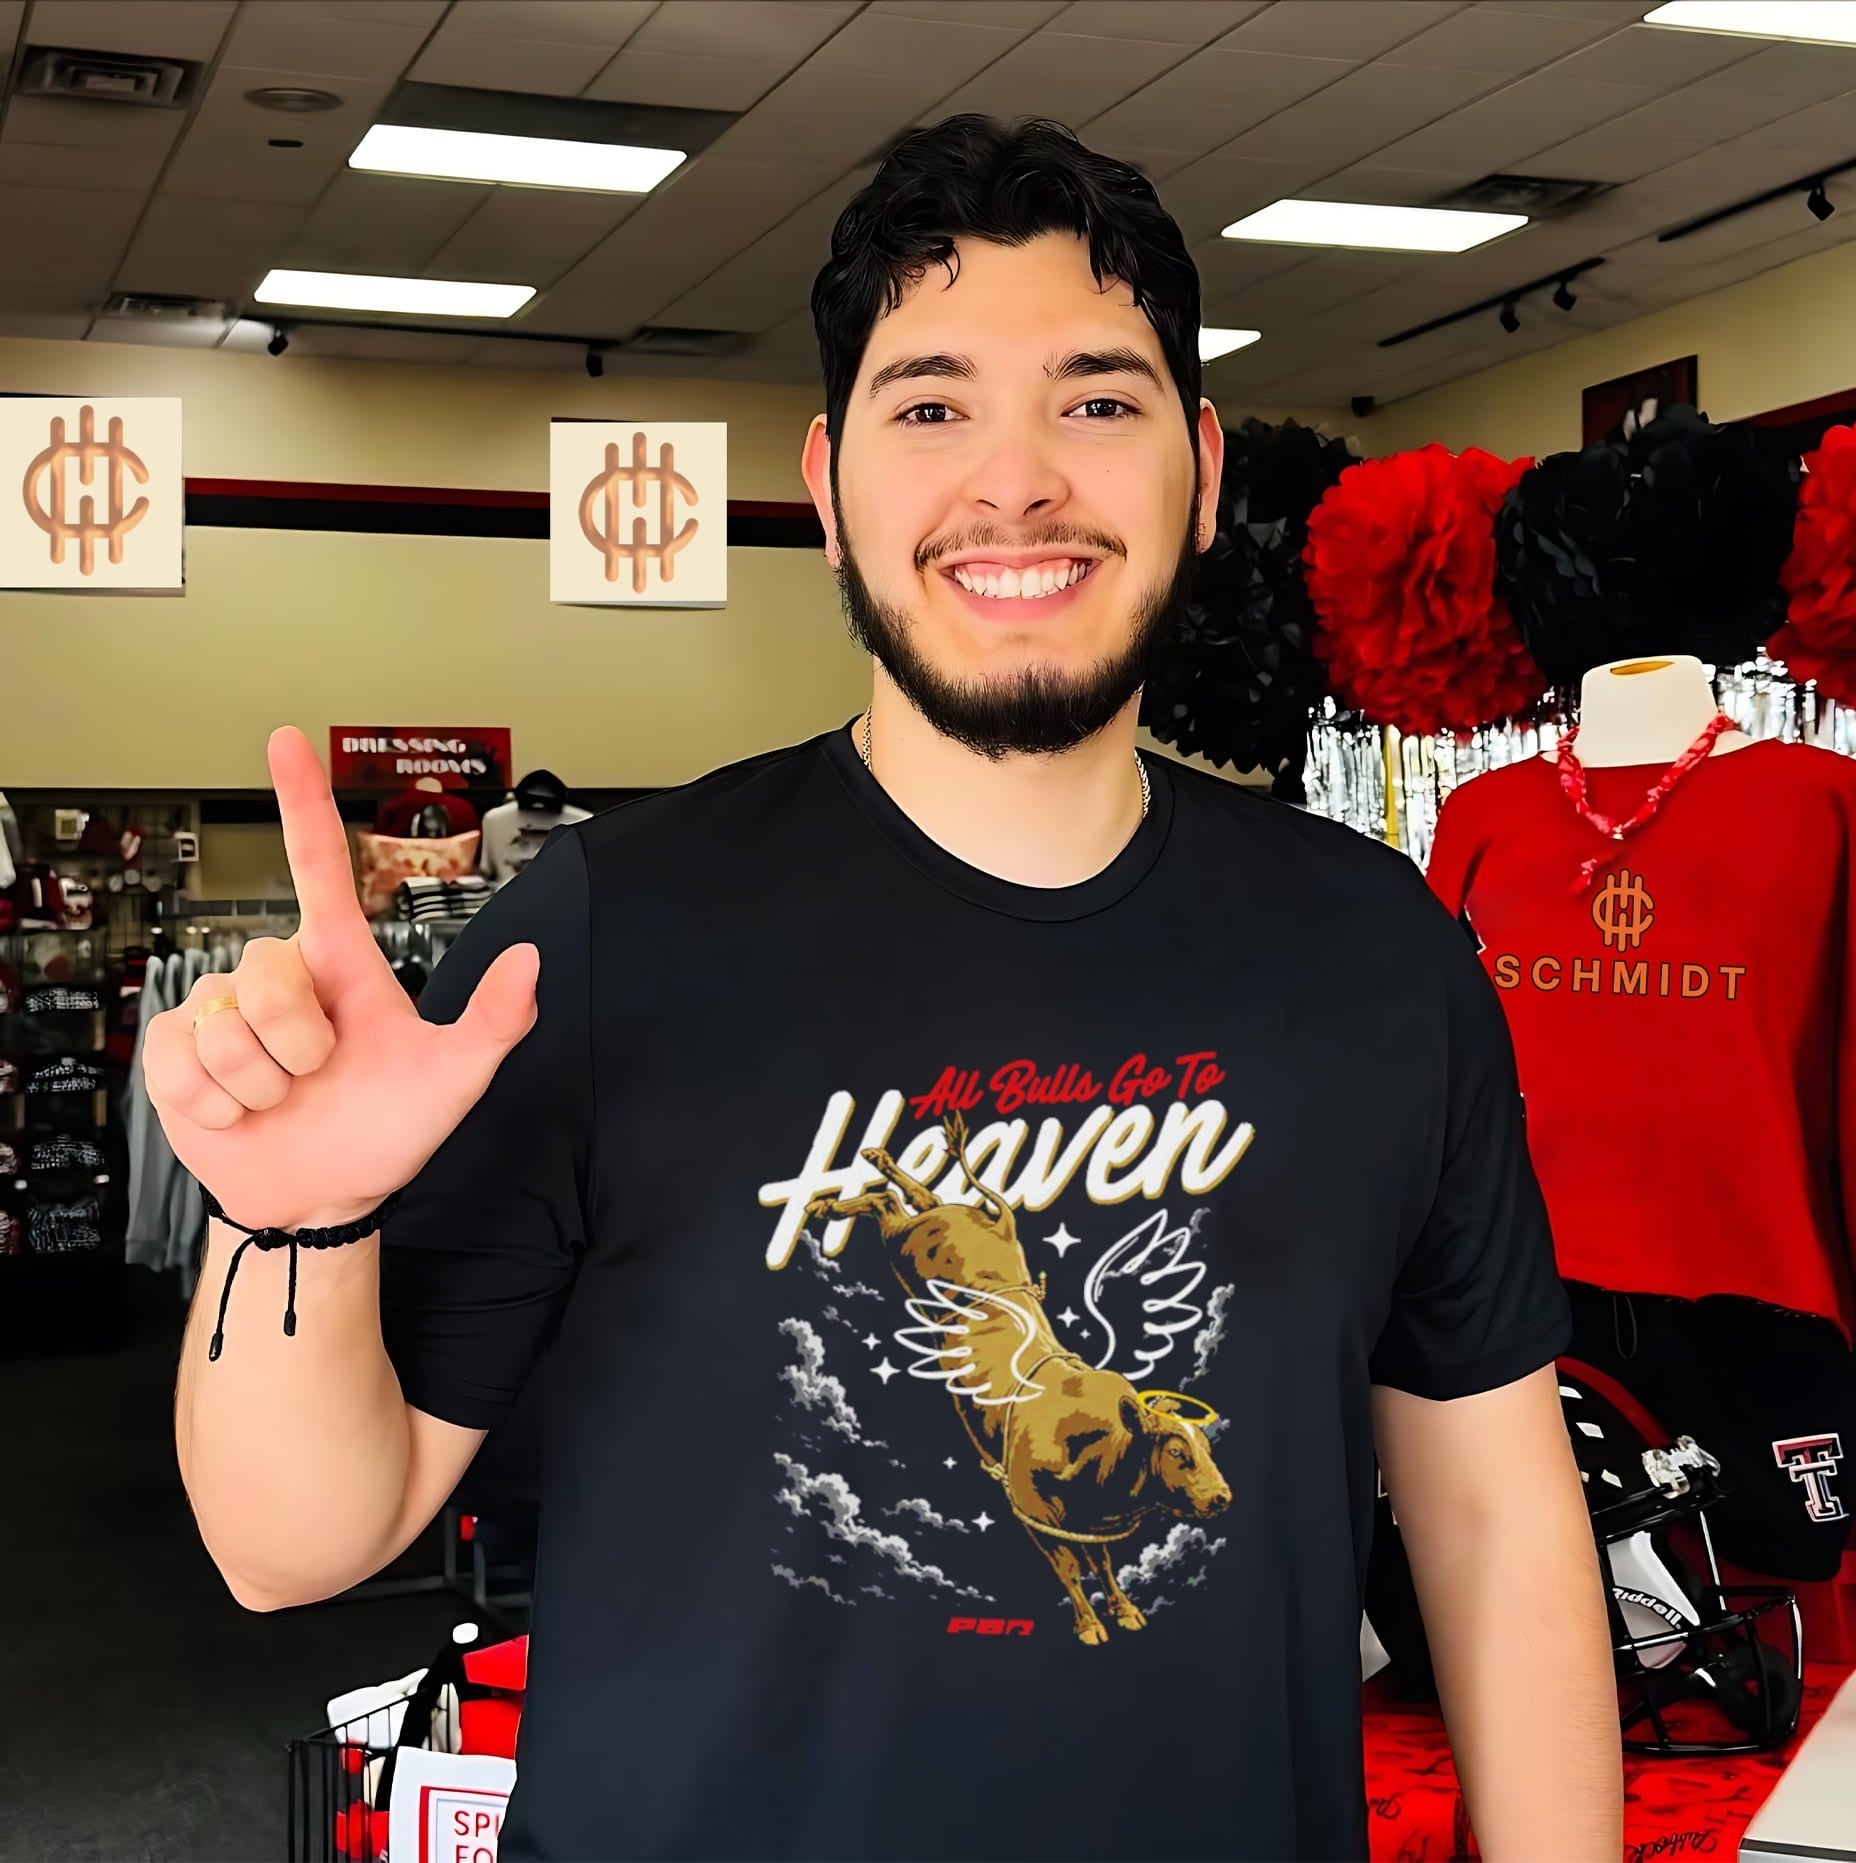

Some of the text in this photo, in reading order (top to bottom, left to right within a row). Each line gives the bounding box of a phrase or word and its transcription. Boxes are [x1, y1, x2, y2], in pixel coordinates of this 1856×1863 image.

[342, 737, 467, 753] DRESSING
[396, 758, 487, 775] ROOMS
[1494, 954, 1746, 1000] SCHMIDT
[910, 1050, 1225, 1119] All Bulls Go To
[758, 1089, 1256, 1271] Heaven
